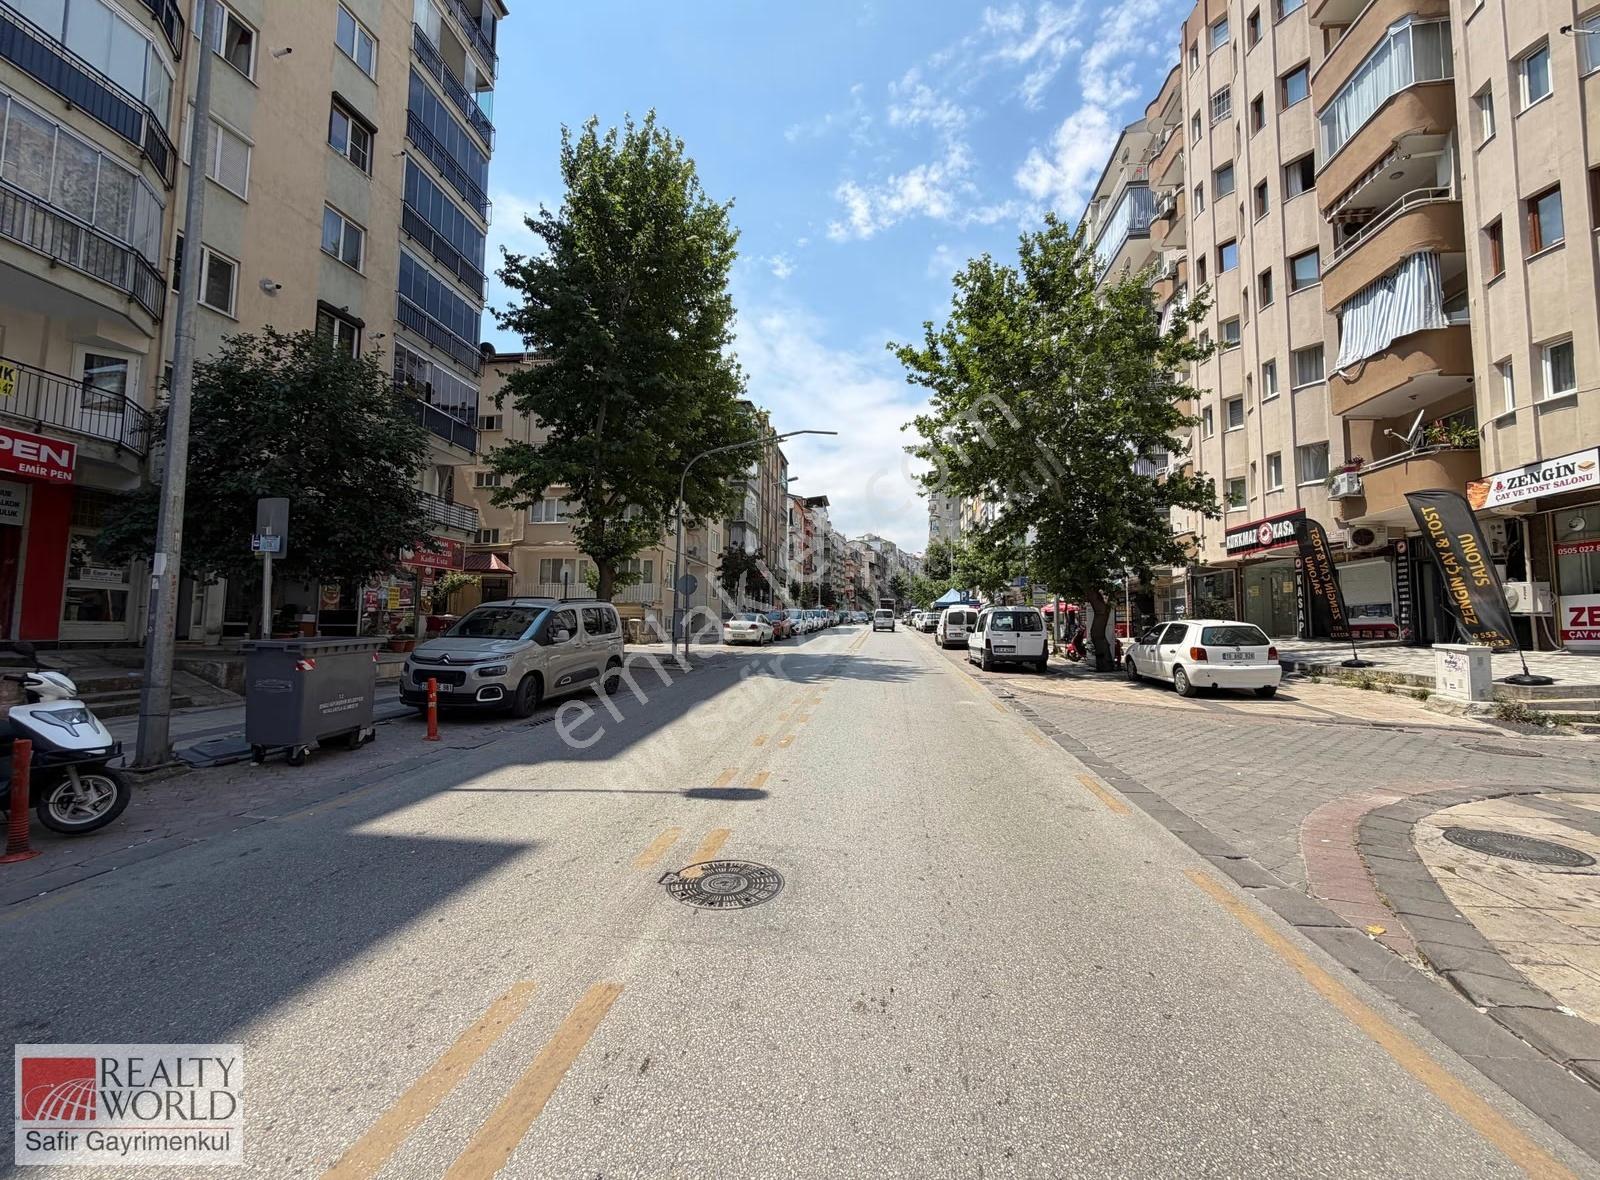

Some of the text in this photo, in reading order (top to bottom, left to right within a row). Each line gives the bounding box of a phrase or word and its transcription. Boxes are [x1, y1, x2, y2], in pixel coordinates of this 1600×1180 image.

[19, 463, 73, 481] EMİR PEN
[1506, 461, 1577, 490] ZENGİN
[1495, 473, 1593, 502] ÇAY VE TOST SALONU
[1272, 520, 1296, 539] KASA
[1421, 506, 1445, 538] TOST
[1435, 537, 1451, 549] &
[1557, 547, 1578, 555] 0505
[1439, 551, 1464, 576] ÇAY
[1457, 533, 1491, 587] SALONU
[1449, 576, 1480, 625] ZENGİN
[1568, 630, 1589, 640] ÇAY
